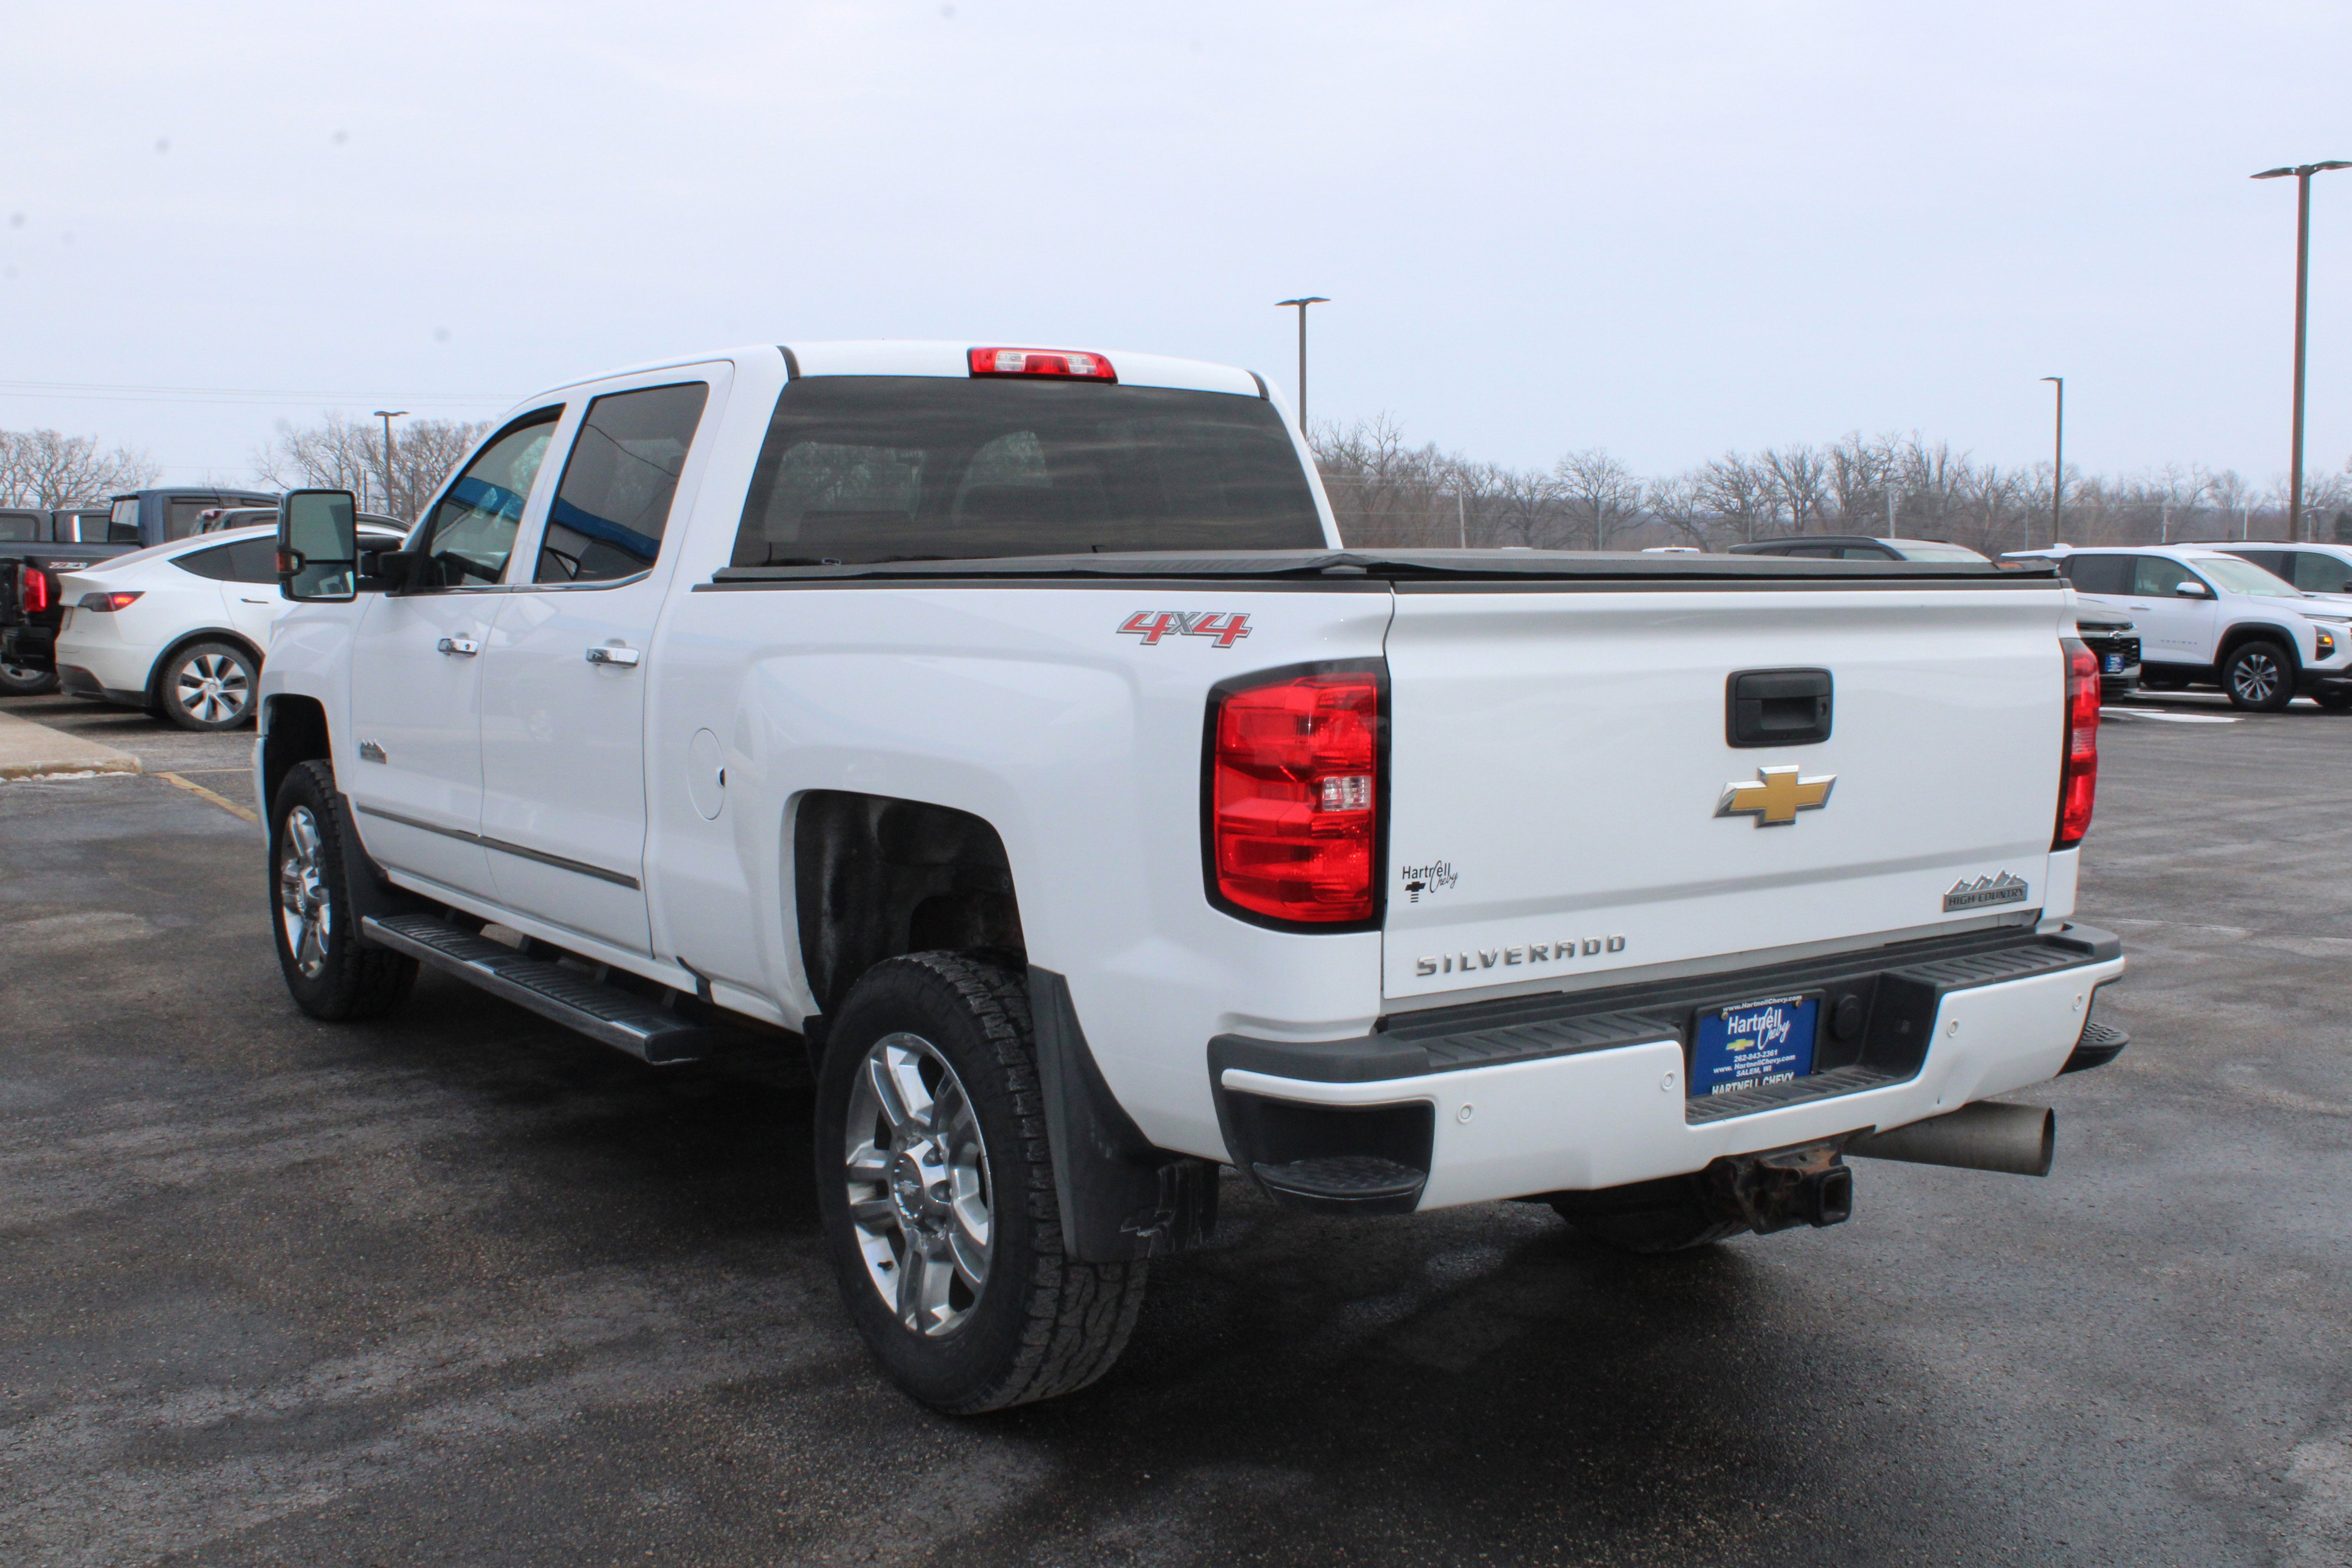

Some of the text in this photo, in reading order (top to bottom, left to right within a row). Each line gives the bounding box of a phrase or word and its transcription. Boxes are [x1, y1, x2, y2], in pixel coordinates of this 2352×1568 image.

[1949, 888, 2024, 906] HIGH COUNTRY
[1417, 933, 1626, 976] SILVERADO
[1722, 995, 1802, 1012] www.HartnellChevy.com
[1727, 1009, 1782, 1035] Hartnell
[1757, 1007, 1791, 1050] Chevy
[1713, 1054, 1796, 1074] www. HartnellChevy.com
[1733, 1049, 1778, 1063] 262-843-2361
[1762, 1071, 1795, 1086] CHEVY
